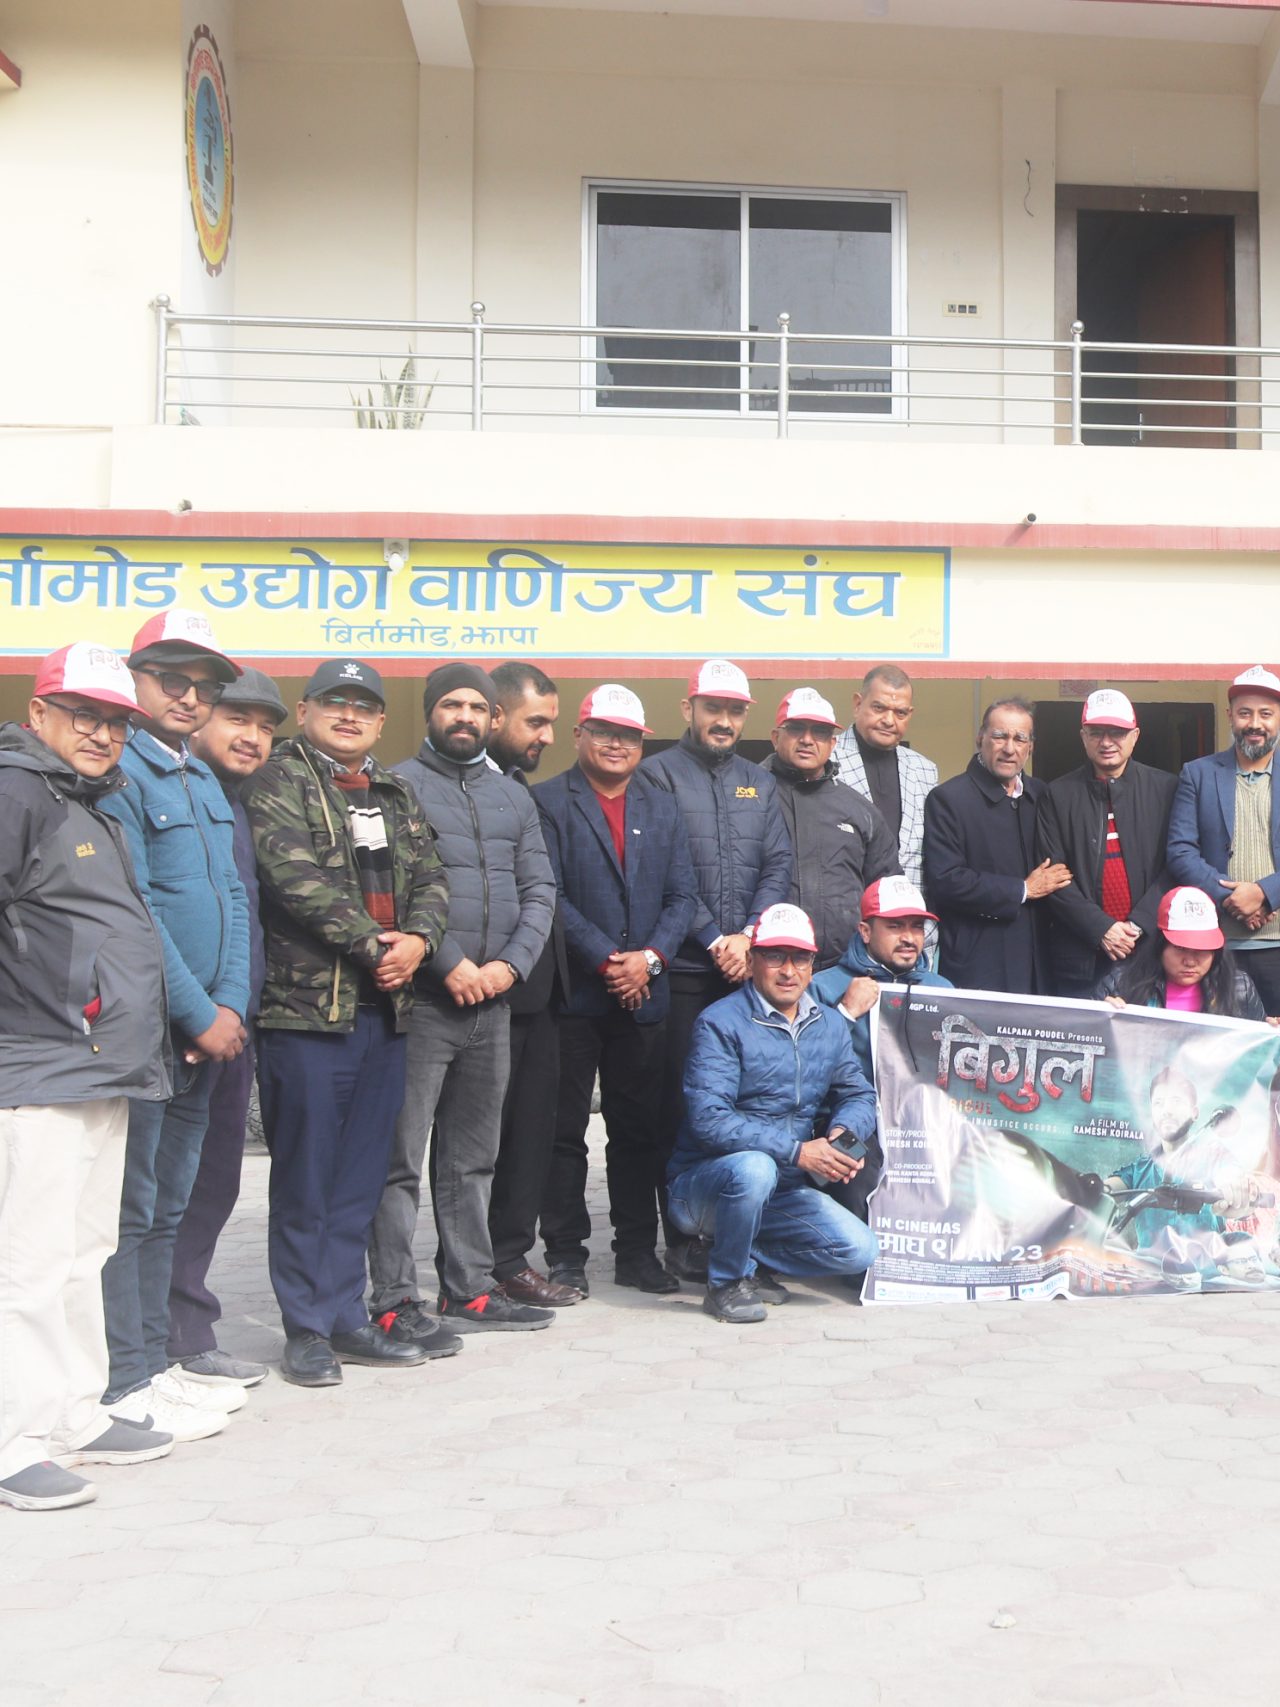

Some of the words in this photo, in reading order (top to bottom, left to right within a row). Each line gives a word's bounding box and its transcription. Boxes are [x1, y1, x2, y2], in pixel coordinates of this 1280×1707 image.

[200, 547, 392, 610] उद्योग
[409, 548, 713, 614] वाणिज्य
[735, 554, 901, 617] संघ
[996, 1025, 1033, 1038] KALPANA
[1035, 1029, 1067, 1040] POUDEL
[931, 1013, 1106, 1113] बिगुल
[1073, 1125, 1108, 1137] RAMESH
[1109, 1128, 1145, 1140] KOIRALA
[1090, 1118, 1097, 1127] A
[1098, 1119, 1117, 1128] FILM
[1119, 1120, 1130, 1130] BY
[876, 1216, 892, 1229] IN
[895, 1218, 961, 1235] CINEMAS
[875, 1231, 928, 1259] माघ
[1010, 1244, 1043, 1263] 23
